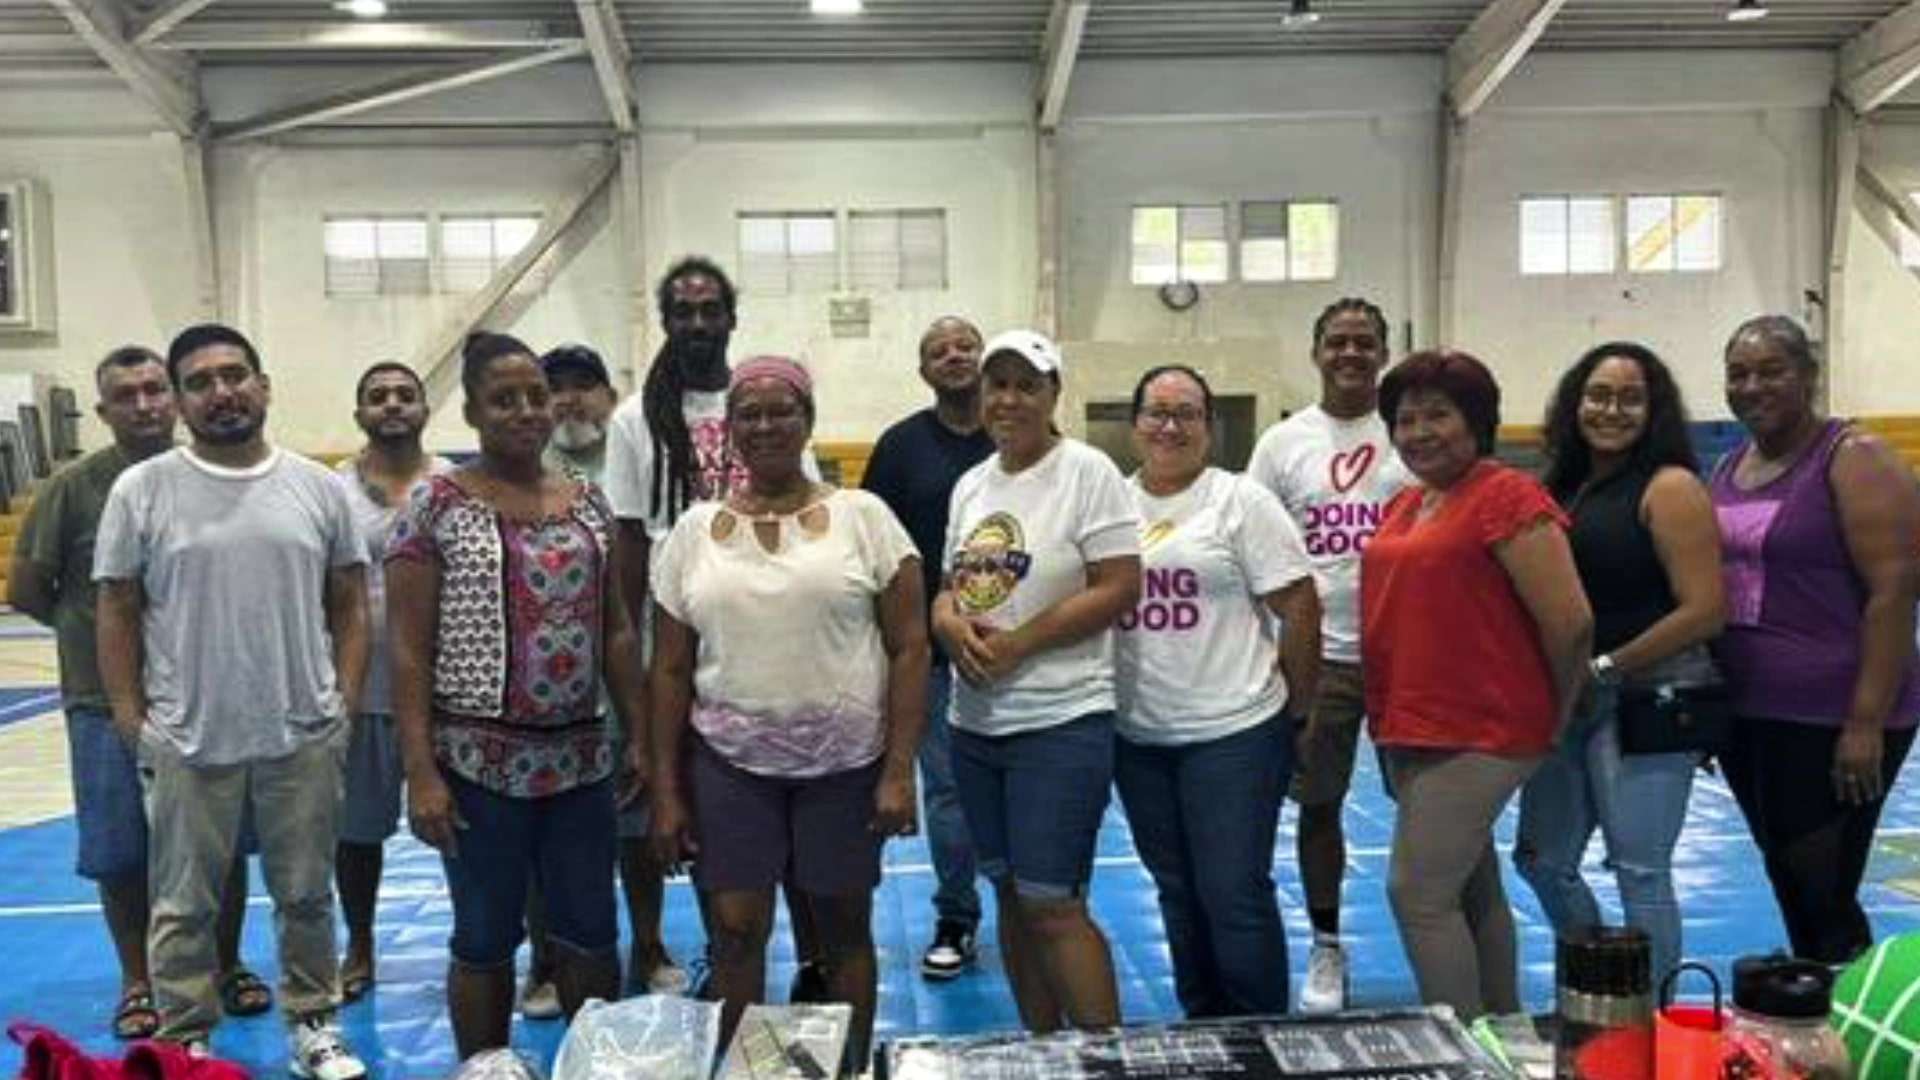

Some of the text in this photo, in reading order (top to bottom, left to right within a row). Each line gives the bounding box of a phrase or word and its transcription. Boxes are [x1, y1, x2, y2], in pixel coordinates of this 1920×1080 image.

[1305, 502, 1380, 529] DOIN
[1146, 568, 1198, 598] NG
[1117, 601, 1199, 632] OOD
